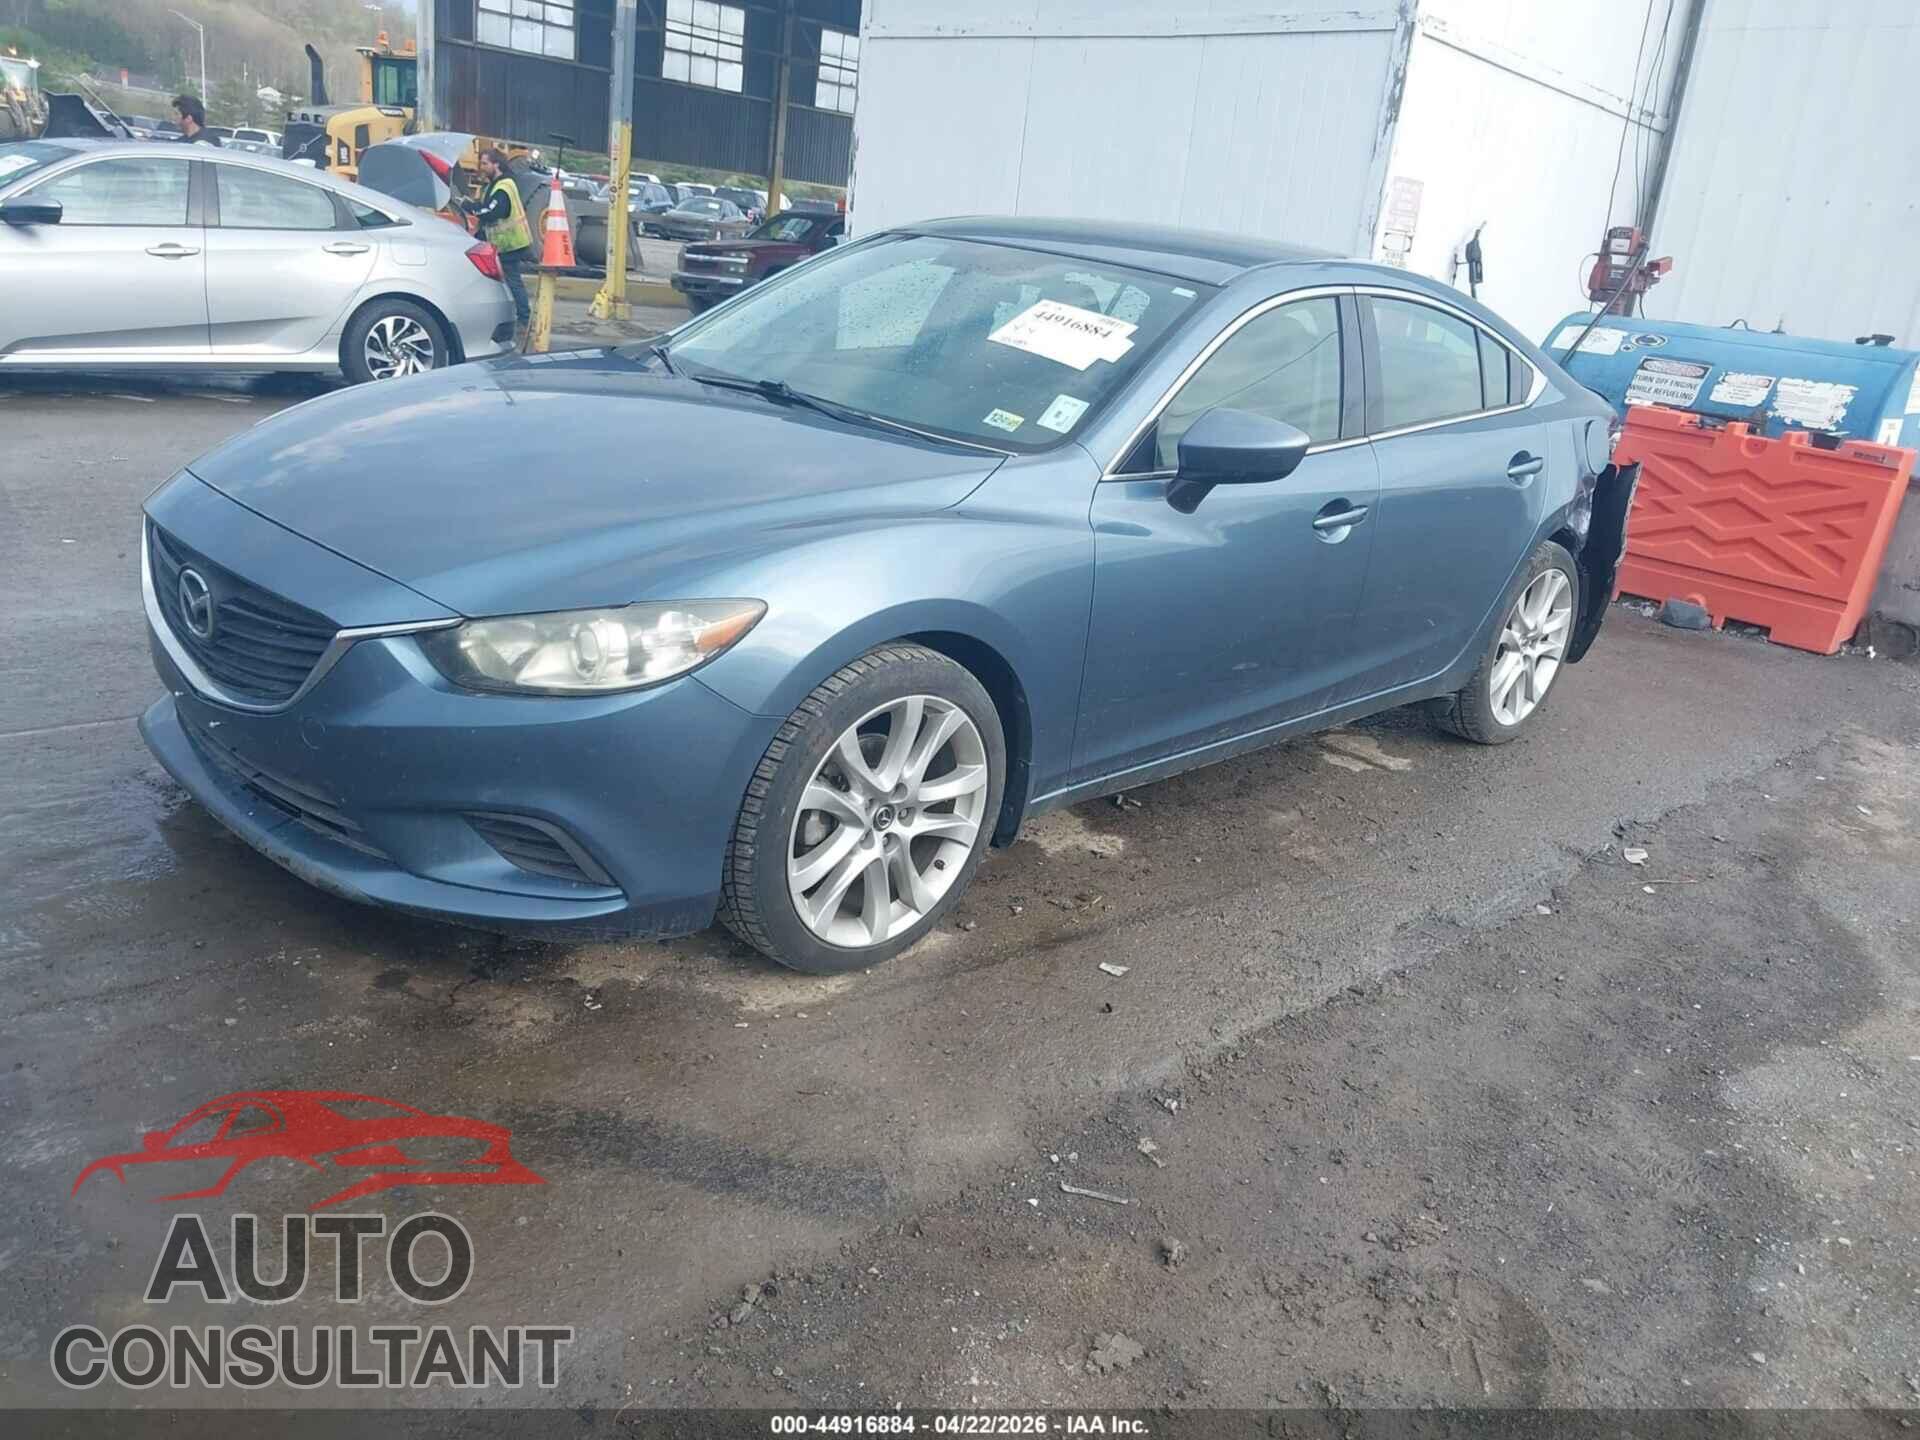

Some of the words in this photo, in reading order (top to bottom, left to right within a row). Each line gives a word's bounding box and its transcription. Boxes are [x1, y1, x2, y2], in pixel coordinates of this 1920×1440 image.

[1035, 311, 1112, 338] 44916884
[1656, 377, 1669, 386] OFF
[1654, 387, 1695, 400] REFUELING
